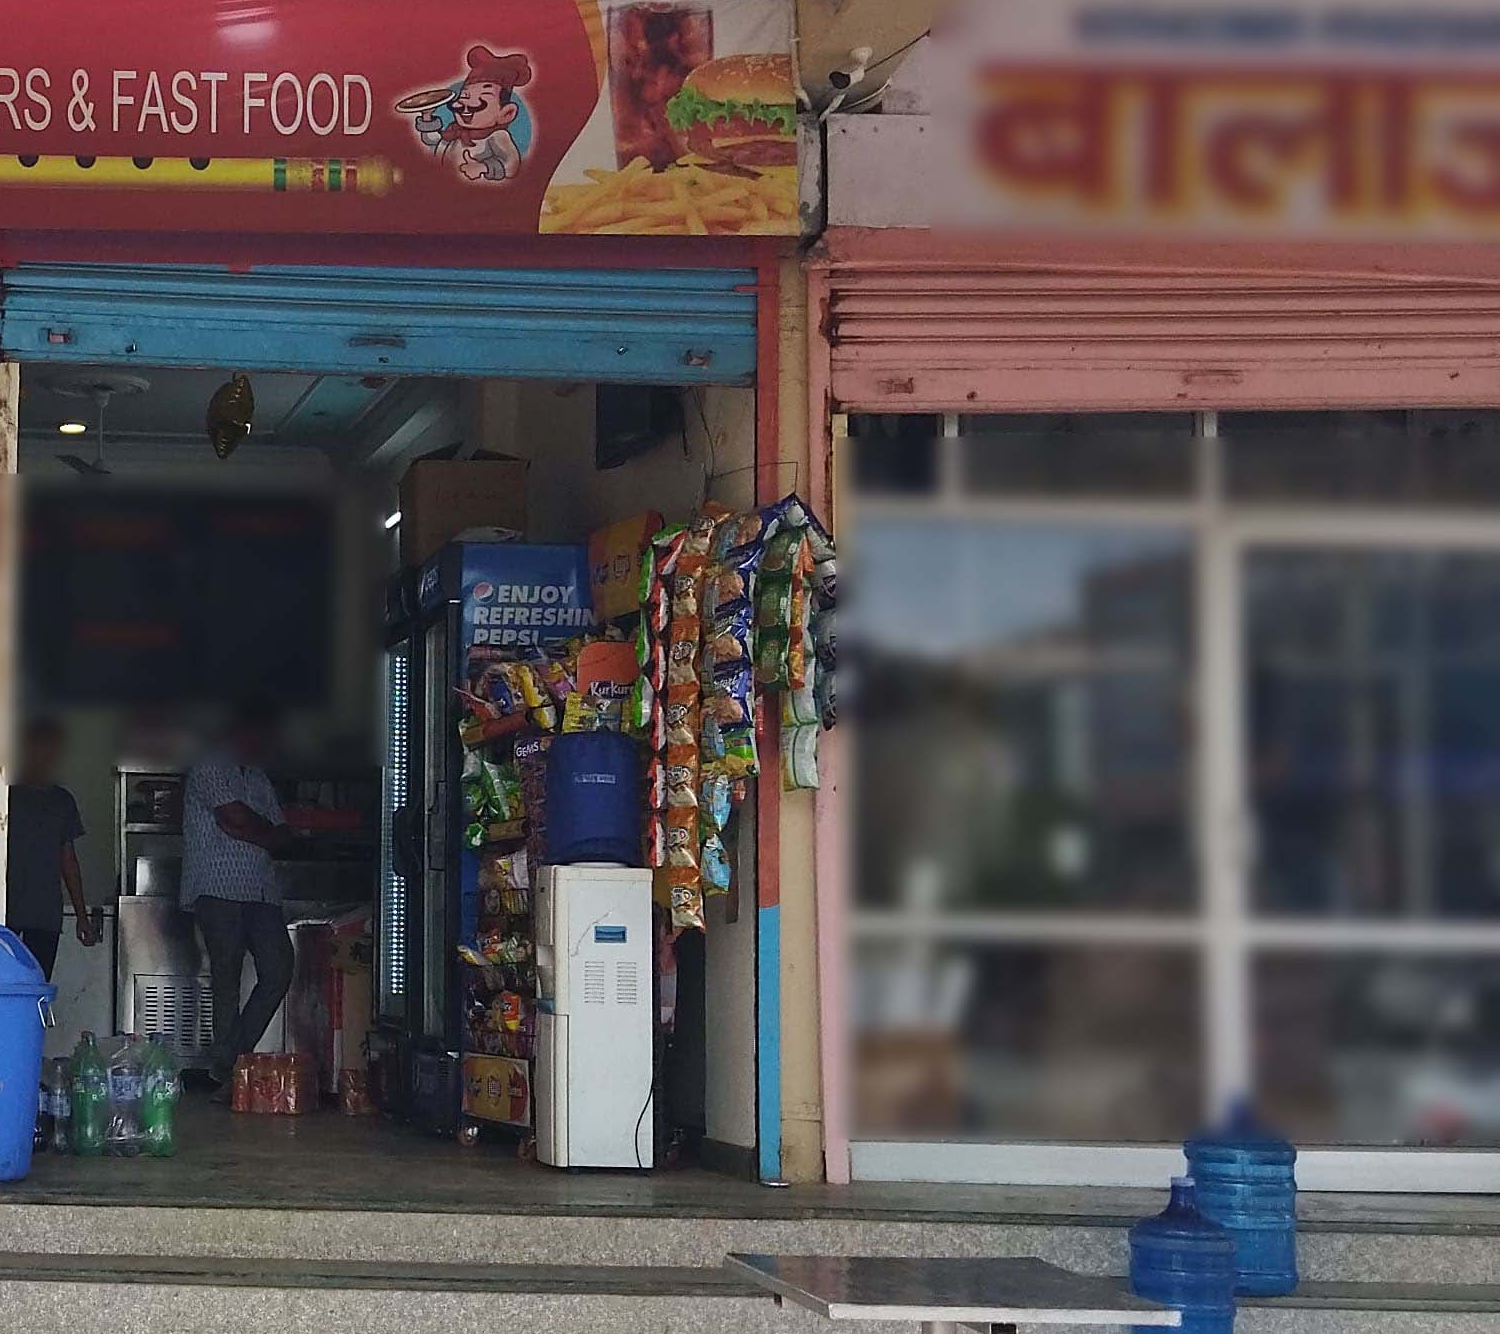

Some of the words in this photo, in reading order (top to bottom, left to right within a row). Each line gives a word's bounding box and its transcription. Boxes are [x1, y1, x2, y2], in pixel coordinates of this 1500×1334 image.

[66, 69, 97, 132] &
[111, 69, 228, 134] FAST
[242, 72, 373, 136] FOOD
[497, 585, 575, 604] ENJOY
[473, 607, 598, 628] REFRESHIN
[473, 629, 540, 646] PEPSI
[515, 740, 540, 758] GEMS
